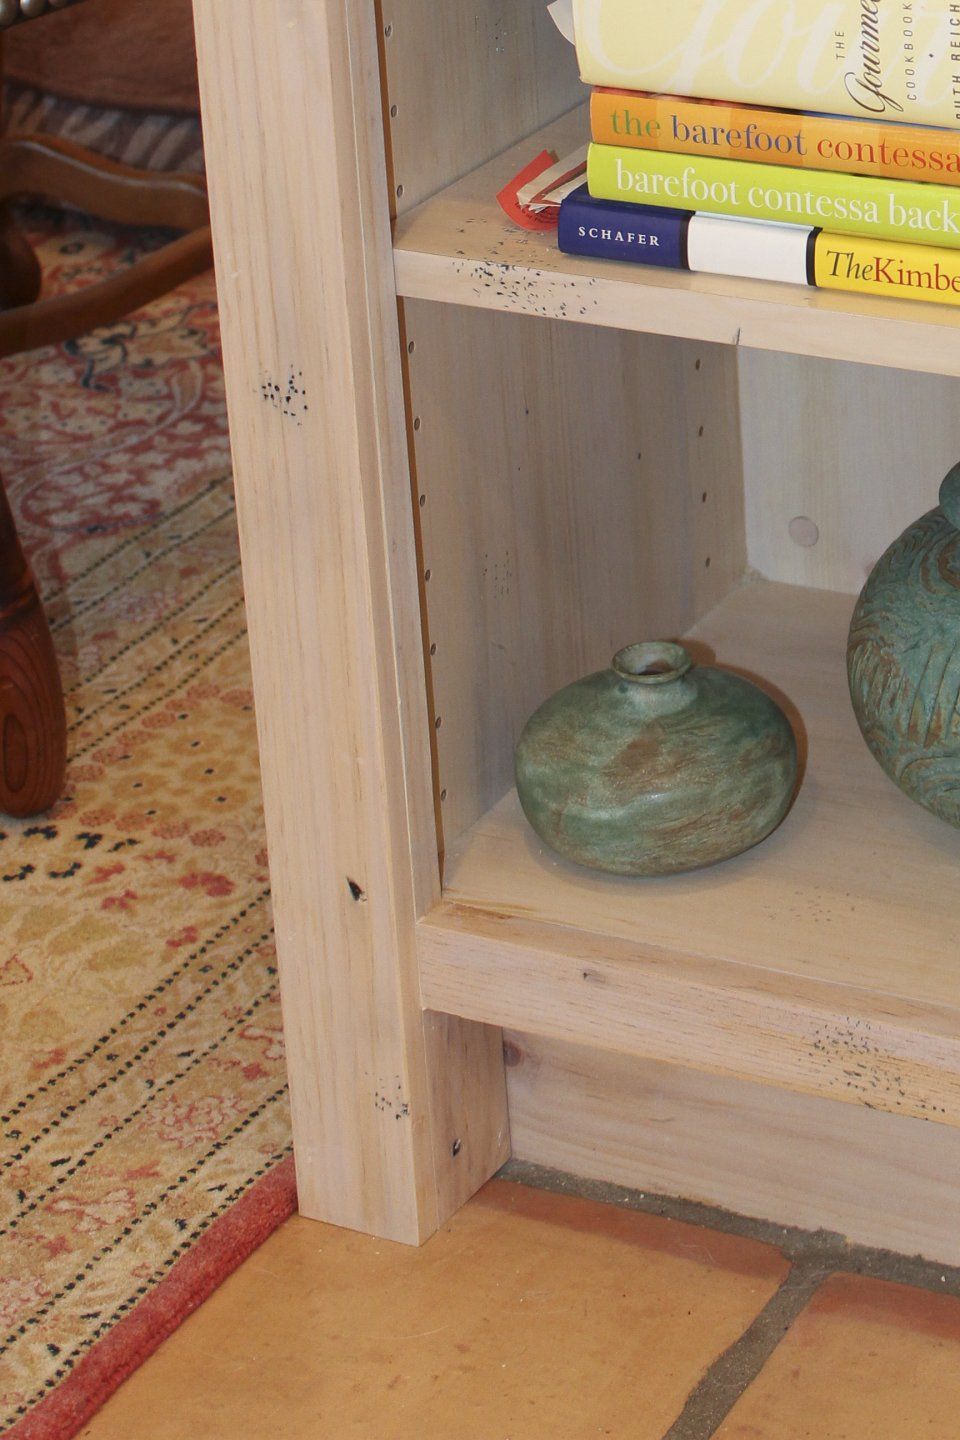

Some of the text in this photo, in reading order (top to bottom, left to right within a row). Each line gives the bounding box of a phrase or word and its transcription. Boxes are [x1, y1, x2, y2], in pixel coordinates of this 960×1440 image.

[835, 31, 846, 60] THE
[902, 3, 917, 101] COOKBOOK
[610, 109, 661, 138] the
[672, 114, 808, 156] barefoot
[615, 158, 740, 206] barefoot
[748, 184, 879, 224] contessa
[888, 193, 960, 235] back
[578, 225, 660, 247] SCHAFER
